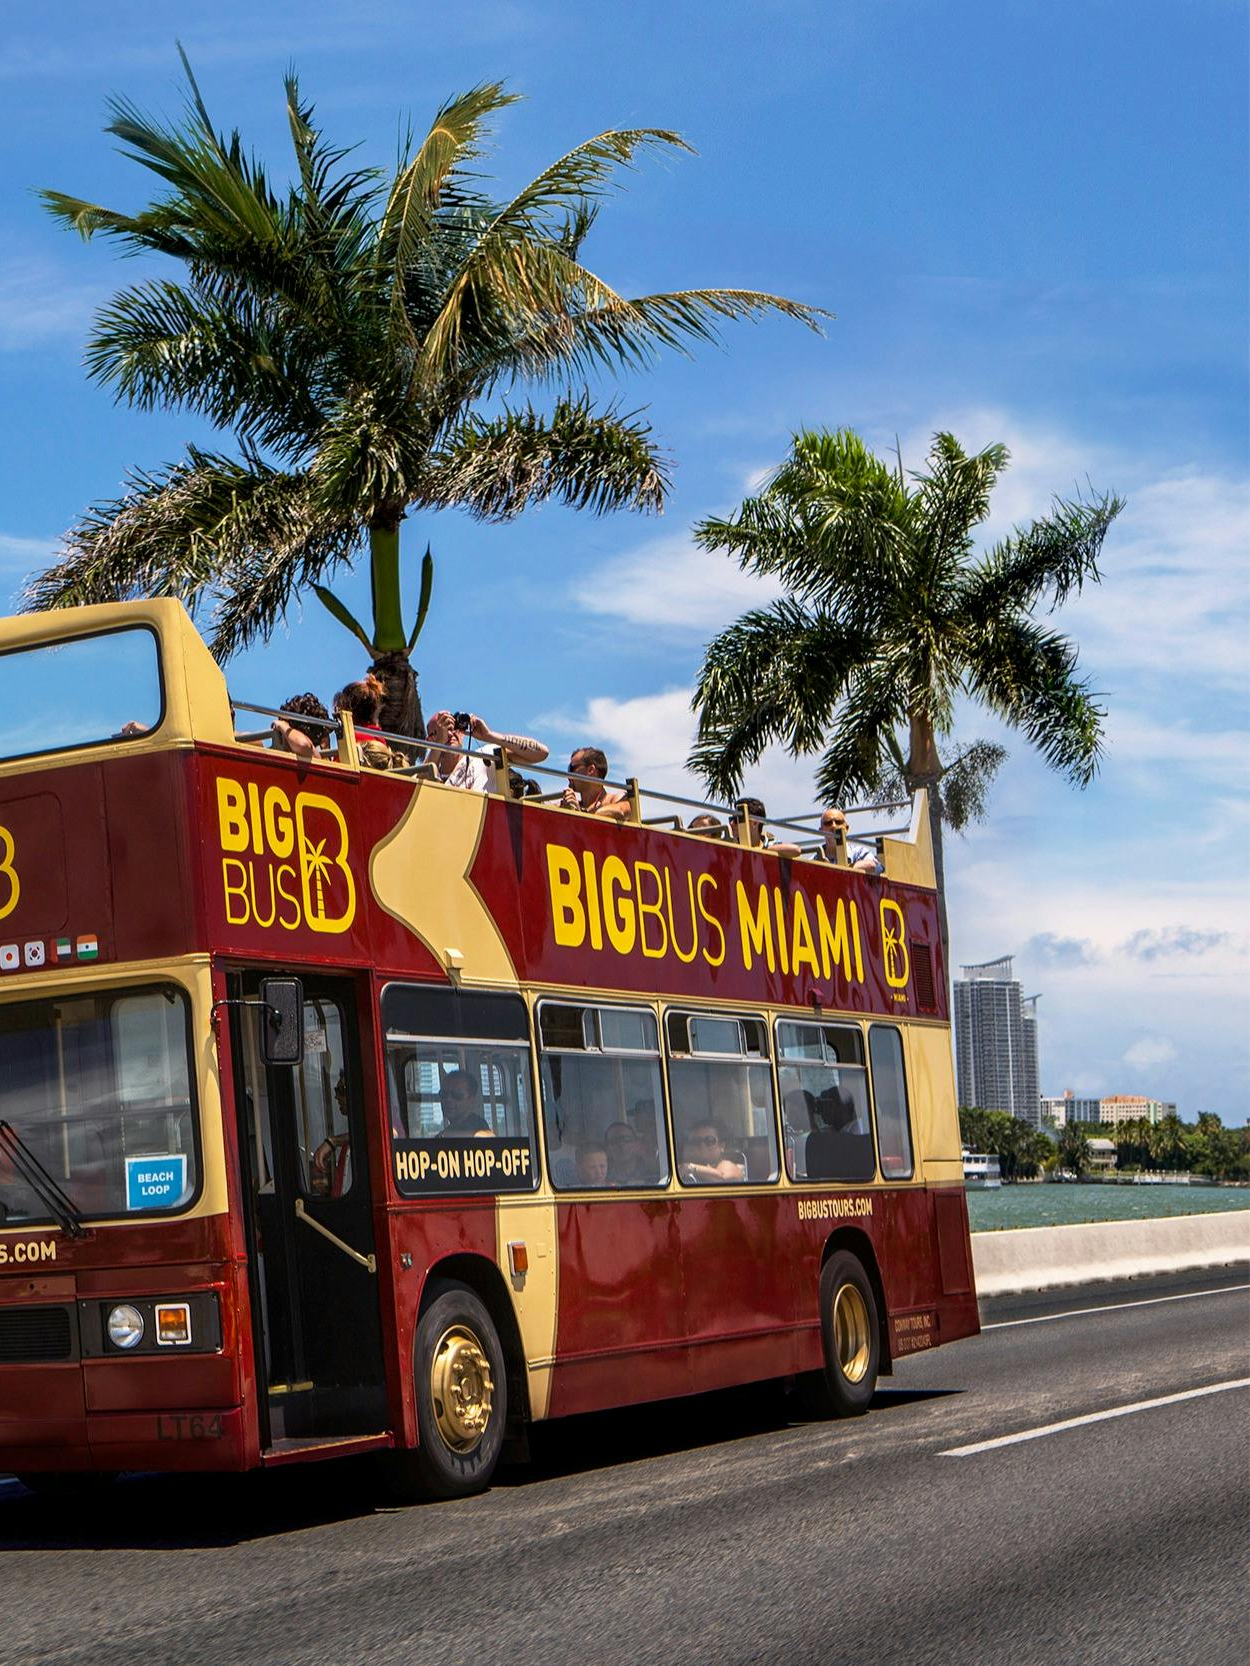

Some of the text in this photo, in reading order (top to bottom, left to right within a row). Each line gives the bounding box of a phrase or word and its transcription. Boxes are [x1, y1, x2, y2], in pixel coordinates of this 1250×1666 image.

[216, 776, 295, 859] BIG
[222, 857, 301, 930] BUS
[736, 880, 865, 984] MIAMI
[137, 1171, 174, 1183] BEACH
[395, 1149, 530, 1181] HOP-ON HOP-OFF
[141, 1184, 170, 1196] LOOP
[797, 1197, 873, 1220] BIGBUSTOURS.COM
[157, 1414, 222, 1441] LT64
